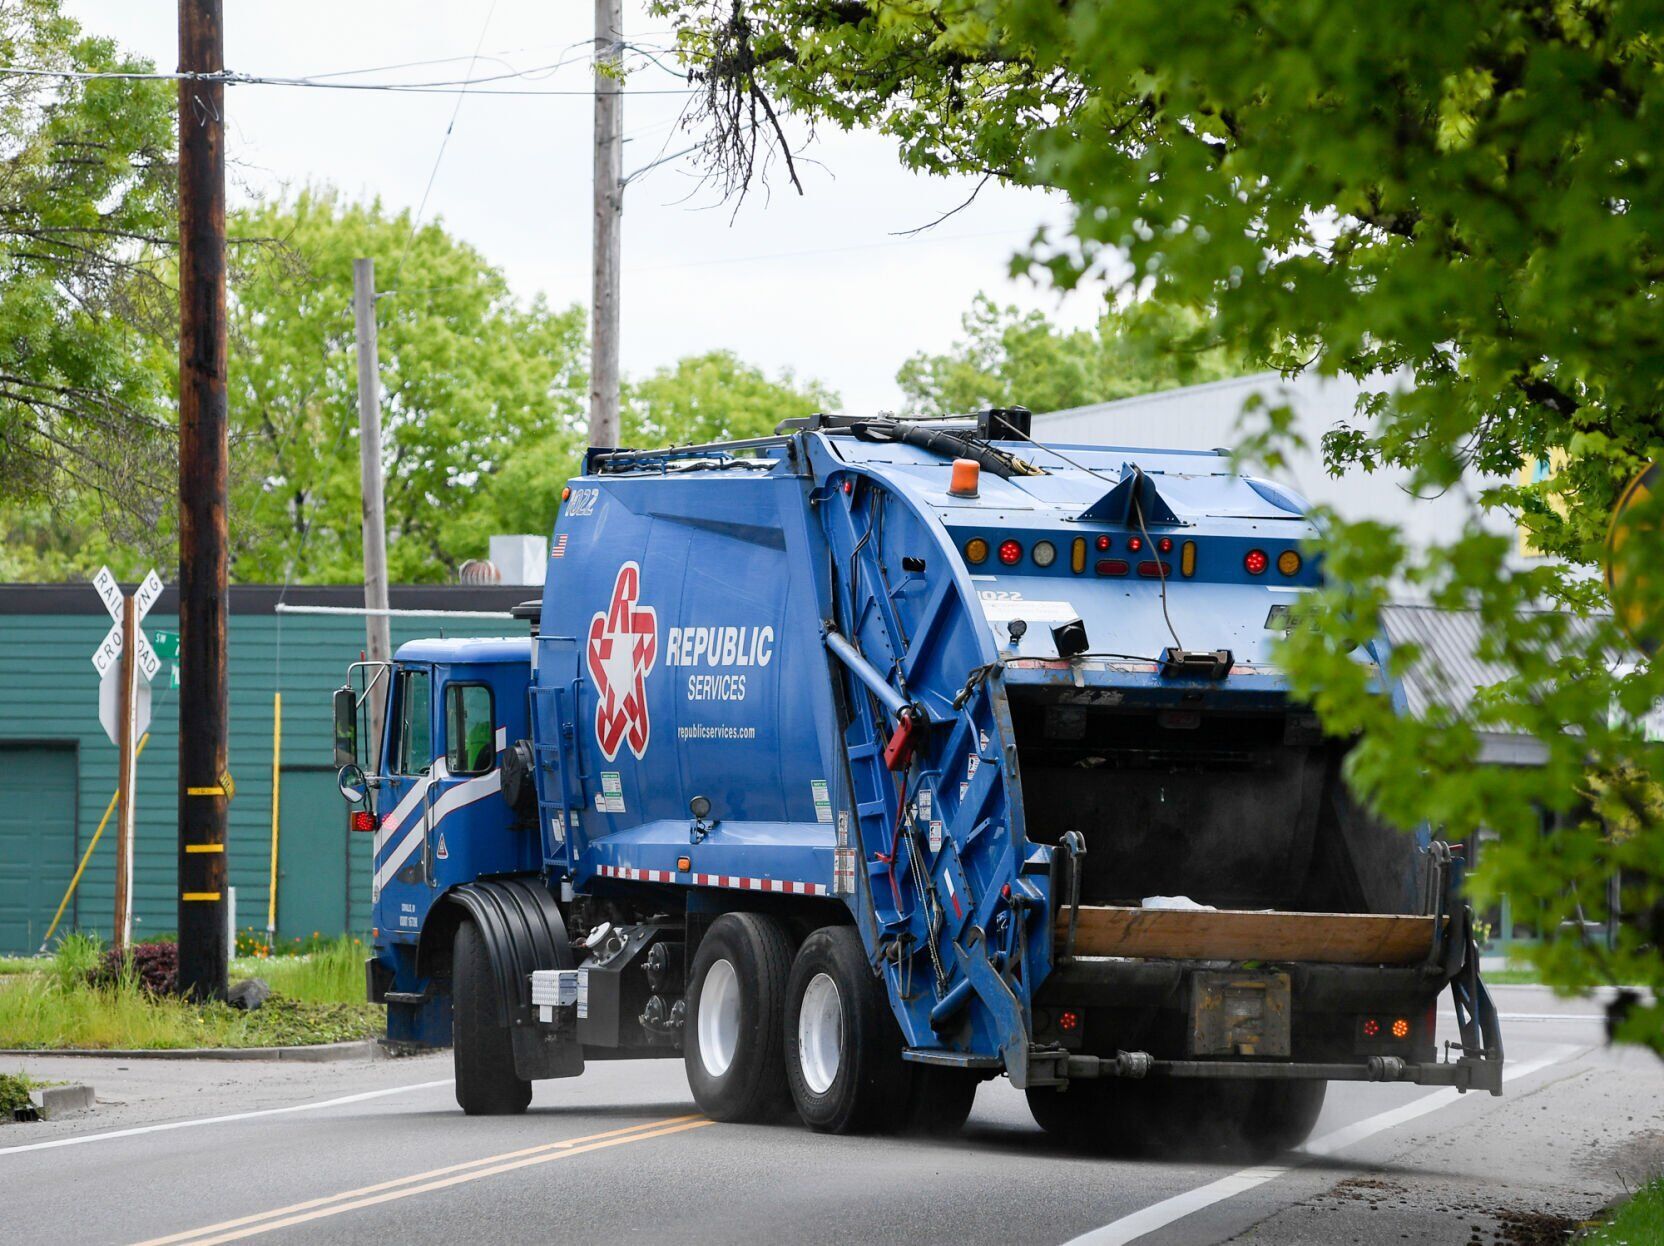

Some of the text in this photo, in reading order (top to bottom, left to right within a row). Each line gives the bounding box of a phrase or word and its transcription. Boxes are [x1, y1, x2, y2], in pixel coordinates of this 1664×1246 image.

[564, 488, 599, 517] 1022
[97, 573, 123, 618] RAIL
[155, 633, 167, 644] SW
[666, 626, 774, 667] REPUBLIC
[687, 674, 746, 701] SERVICES
[677, 723, 756, 742] republicservices.com
